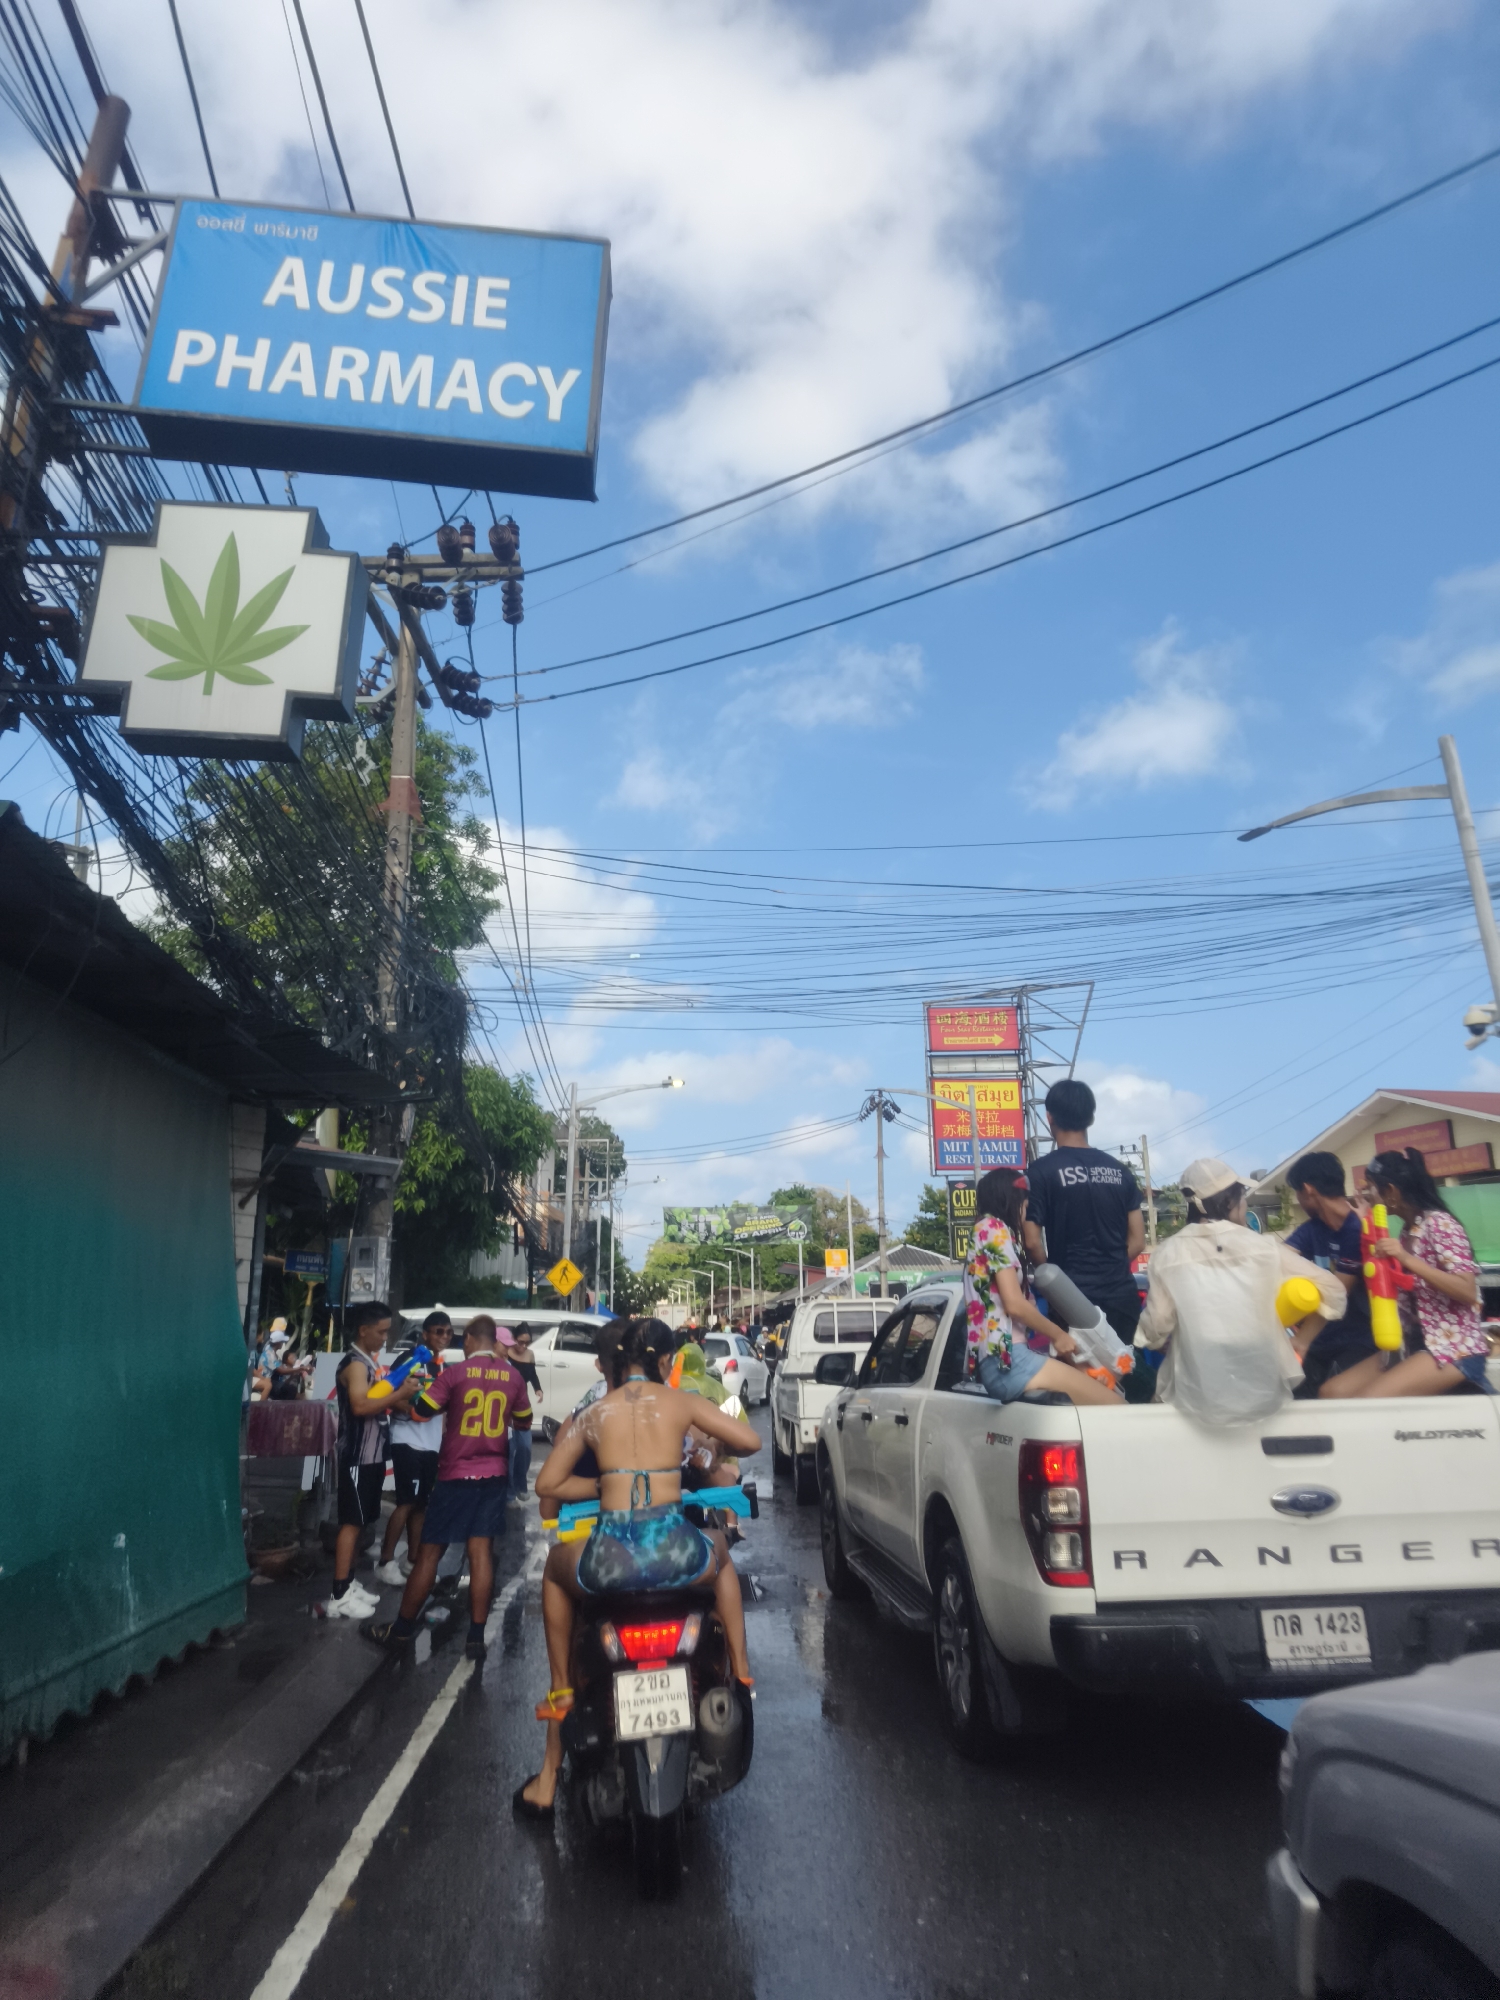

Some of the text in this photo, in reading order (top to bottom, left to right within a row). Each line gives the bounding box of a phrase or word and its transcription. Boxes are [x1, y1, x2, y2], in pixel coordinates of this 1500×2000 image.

[262, 256, 511, 330] AUSSIE
[167, 328, 582, 422] PHARMACY
[940, 1025, 1007, 1034] Four Seas Restaurant
[940, 1084, 1014, 1108] มิตสมุย
[943, 1141, 969, 1153] MIT
[945, 1154, 1018, 1164] RESTURANT
[1058, 1165, 1123, 1187] ISS SPORTS
[744, 1217, 780, 1226] GRAND
[954, 1209, 974, 1217] INDIAN
[734, 1222, 784, 1235] OPENING
[751, 1226, 787, 1238] APRIL
[460, 1388, 507, 1438] 20
[412, 1479, 420, 1496] 7
[1113, 1537, 1500, 1570] RANGER
[1314, 1611, 1361, 1635] 1423
[620, 1691, 687, 1713] กรุงเทพมหานคร
[629, 1708, 681, 1733] 7493
